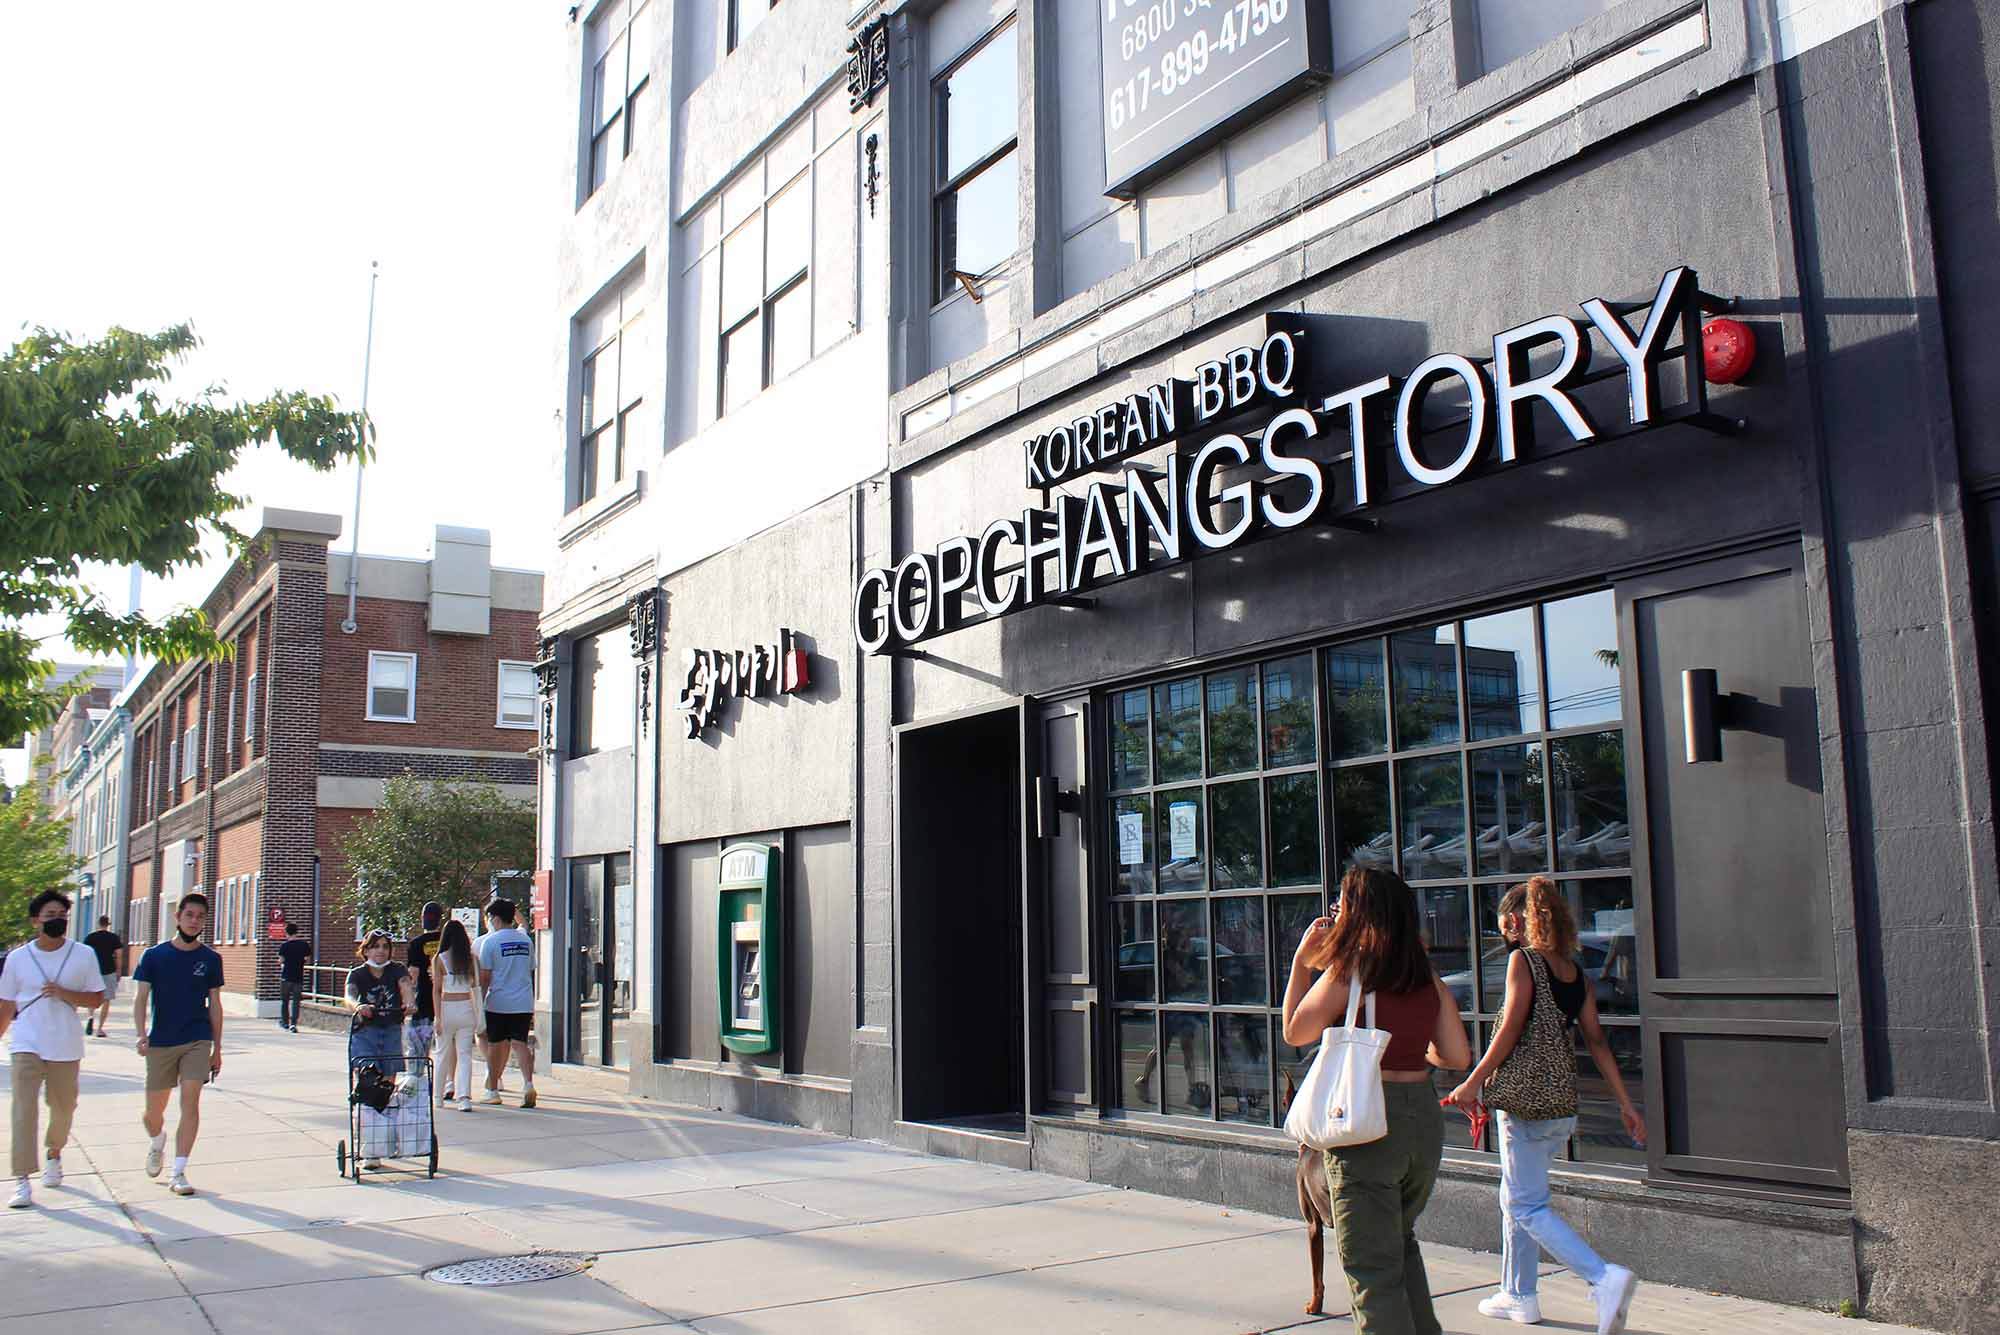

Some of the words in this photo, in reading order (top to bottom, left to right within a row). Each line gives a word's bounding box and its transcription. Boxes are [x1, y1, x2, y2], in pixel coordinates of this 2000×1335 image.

[1121, 0, 1176, 61] 6800
[853, 266, 1690, 656] GOPCHANGSTORY
[1023, 378, 1176, 488] KOREAN
[1197, 330, 1298, 421] BBQ
[728, 854, 757, 879] ATM
